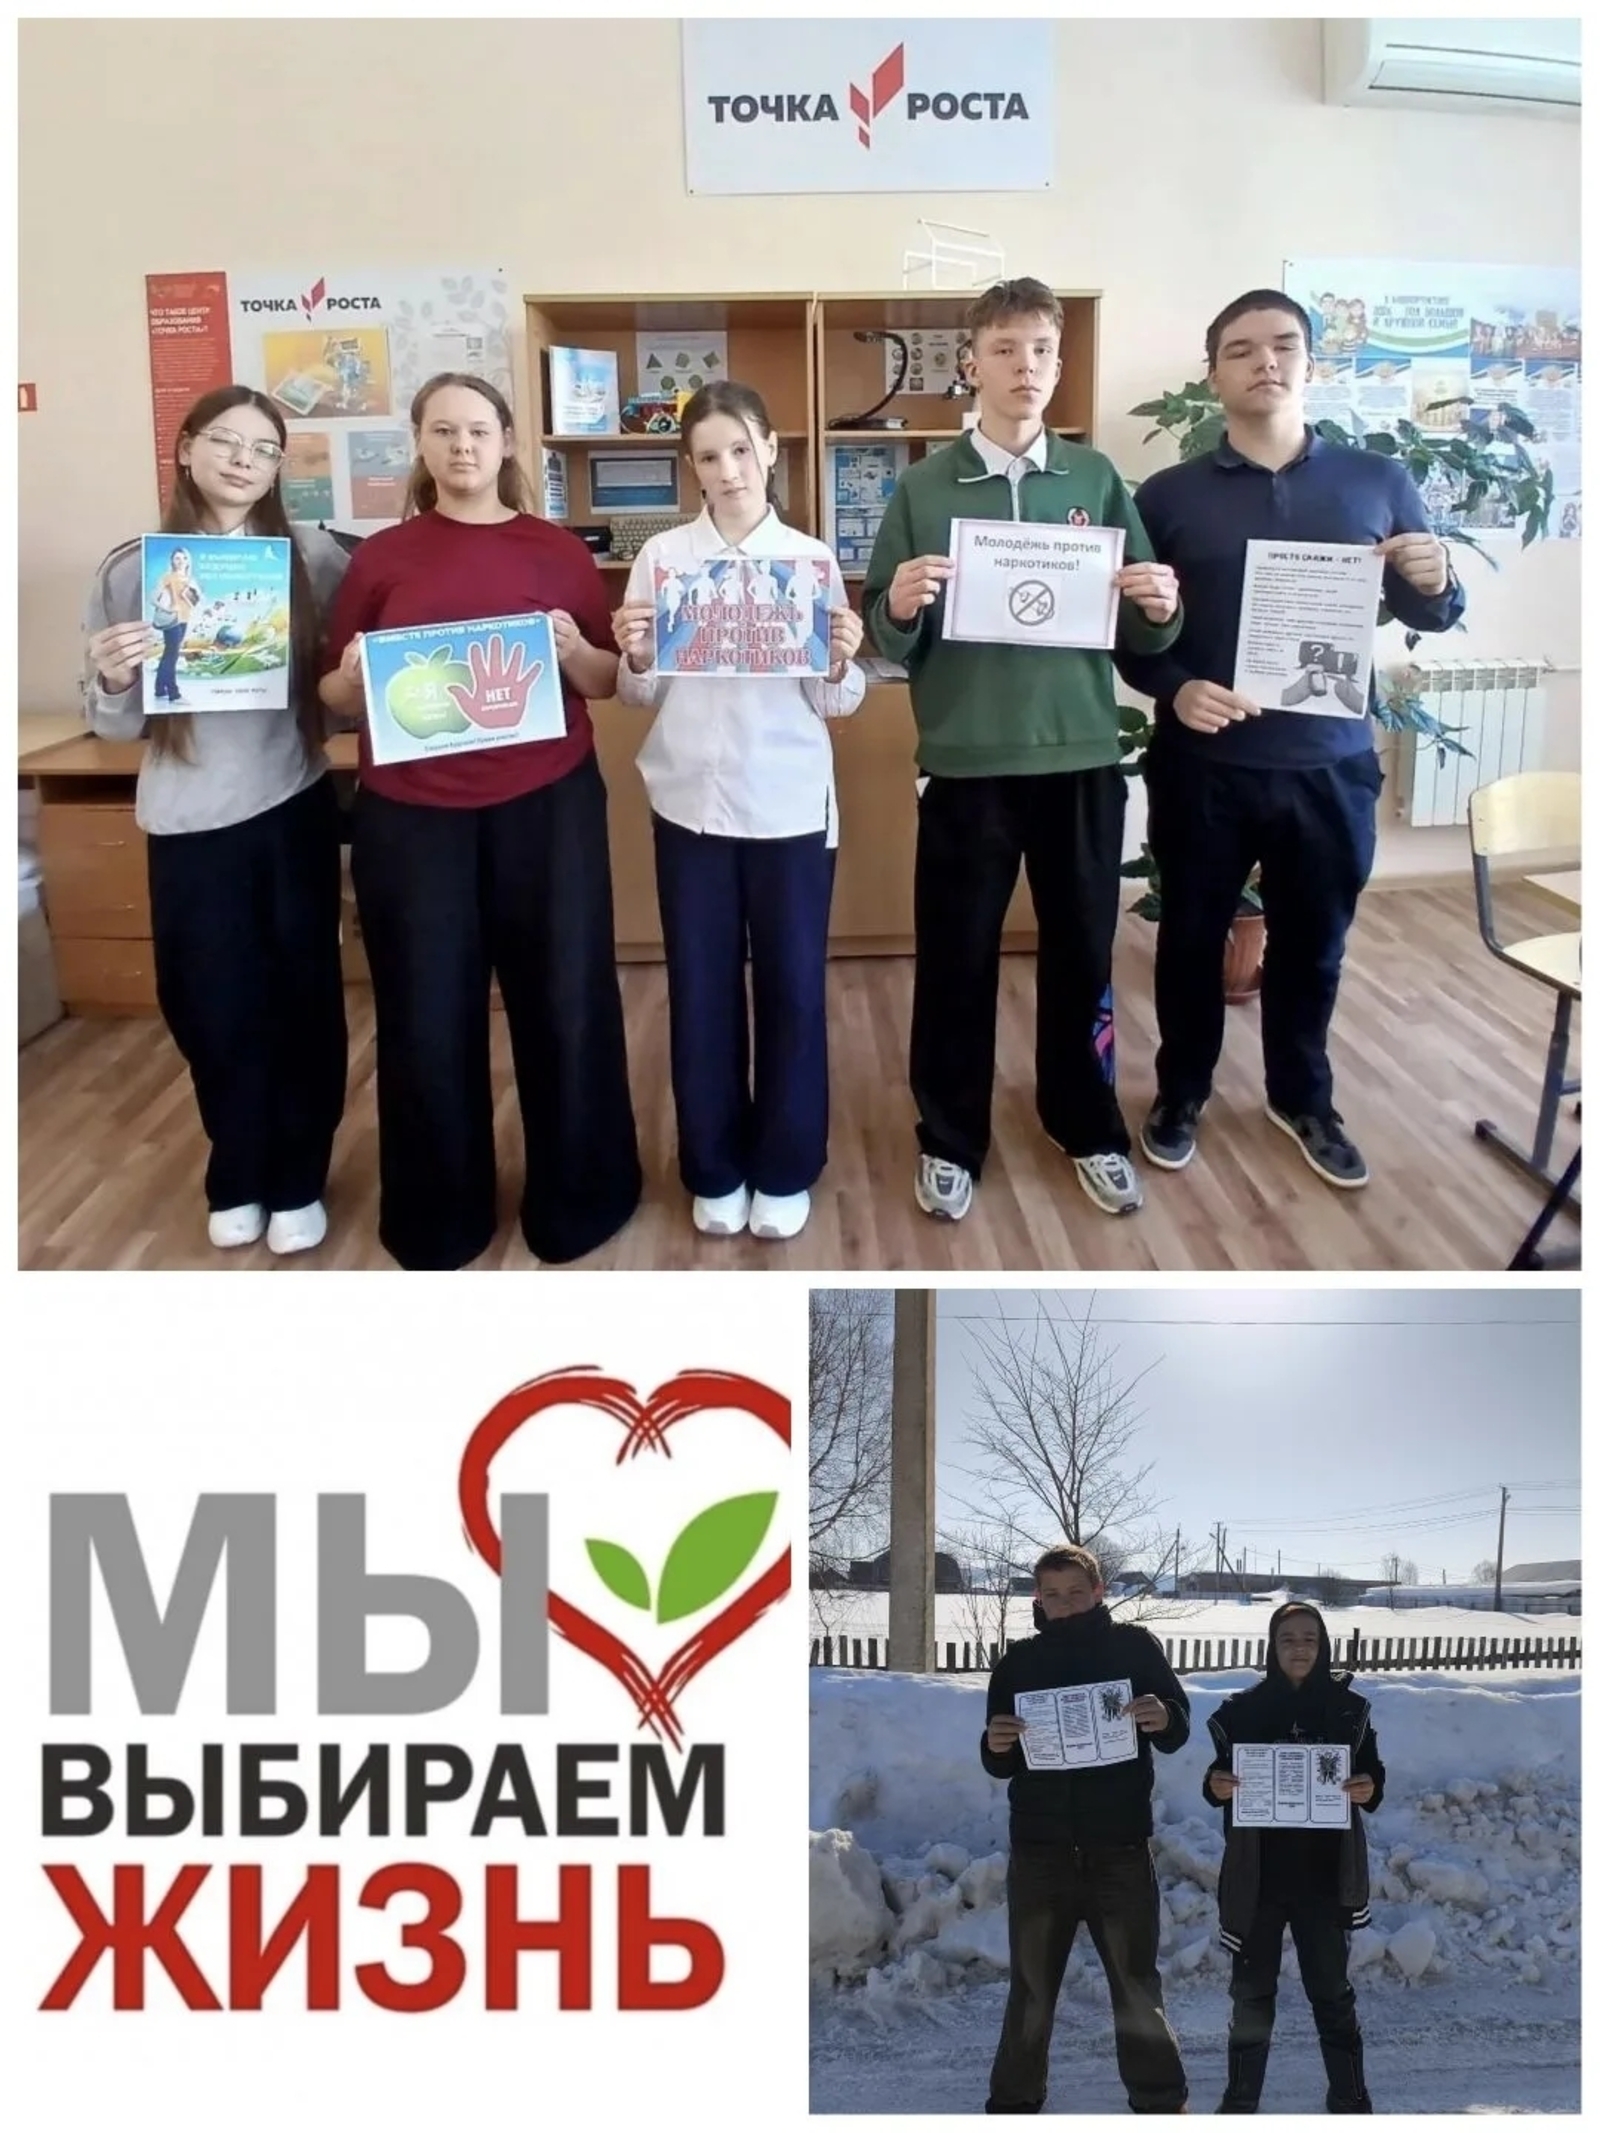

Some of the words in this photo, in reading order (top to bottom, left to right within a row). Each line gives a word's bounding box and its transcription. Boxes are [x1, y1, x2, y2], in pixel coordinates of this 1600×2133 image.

[708, 94, 839, 123] ТОЧКА
[907, 92, 1029, 120] РОСТА
[241, 299, 297, 312] ТОЧКА
[327, 297, 381, 311] РОСТА
[974, 535, 1050, 551] Молодёжь
[1053, 541, 1102, 554] против
[994, 558, 1080, 571] наркотиков!
[1268, 552, 1300, 560] ПРОСТО
[1302, 553, 1333, 562] СКАЖИ
[423, 628, 465, 641] ПРОТИВ
[700, 626, 786, 644] ПРОТИВ
[676, 648, 811, 666] НАРКОТИКОВ
[486, 687, 511, 703] НЕТ
[50, 1493, 549, 1715] МЫ
[41, 1744, 725, 1836] ВЫБИРАЕМ
[38, 1862, 726, 2013] ЖИЗНЬ
